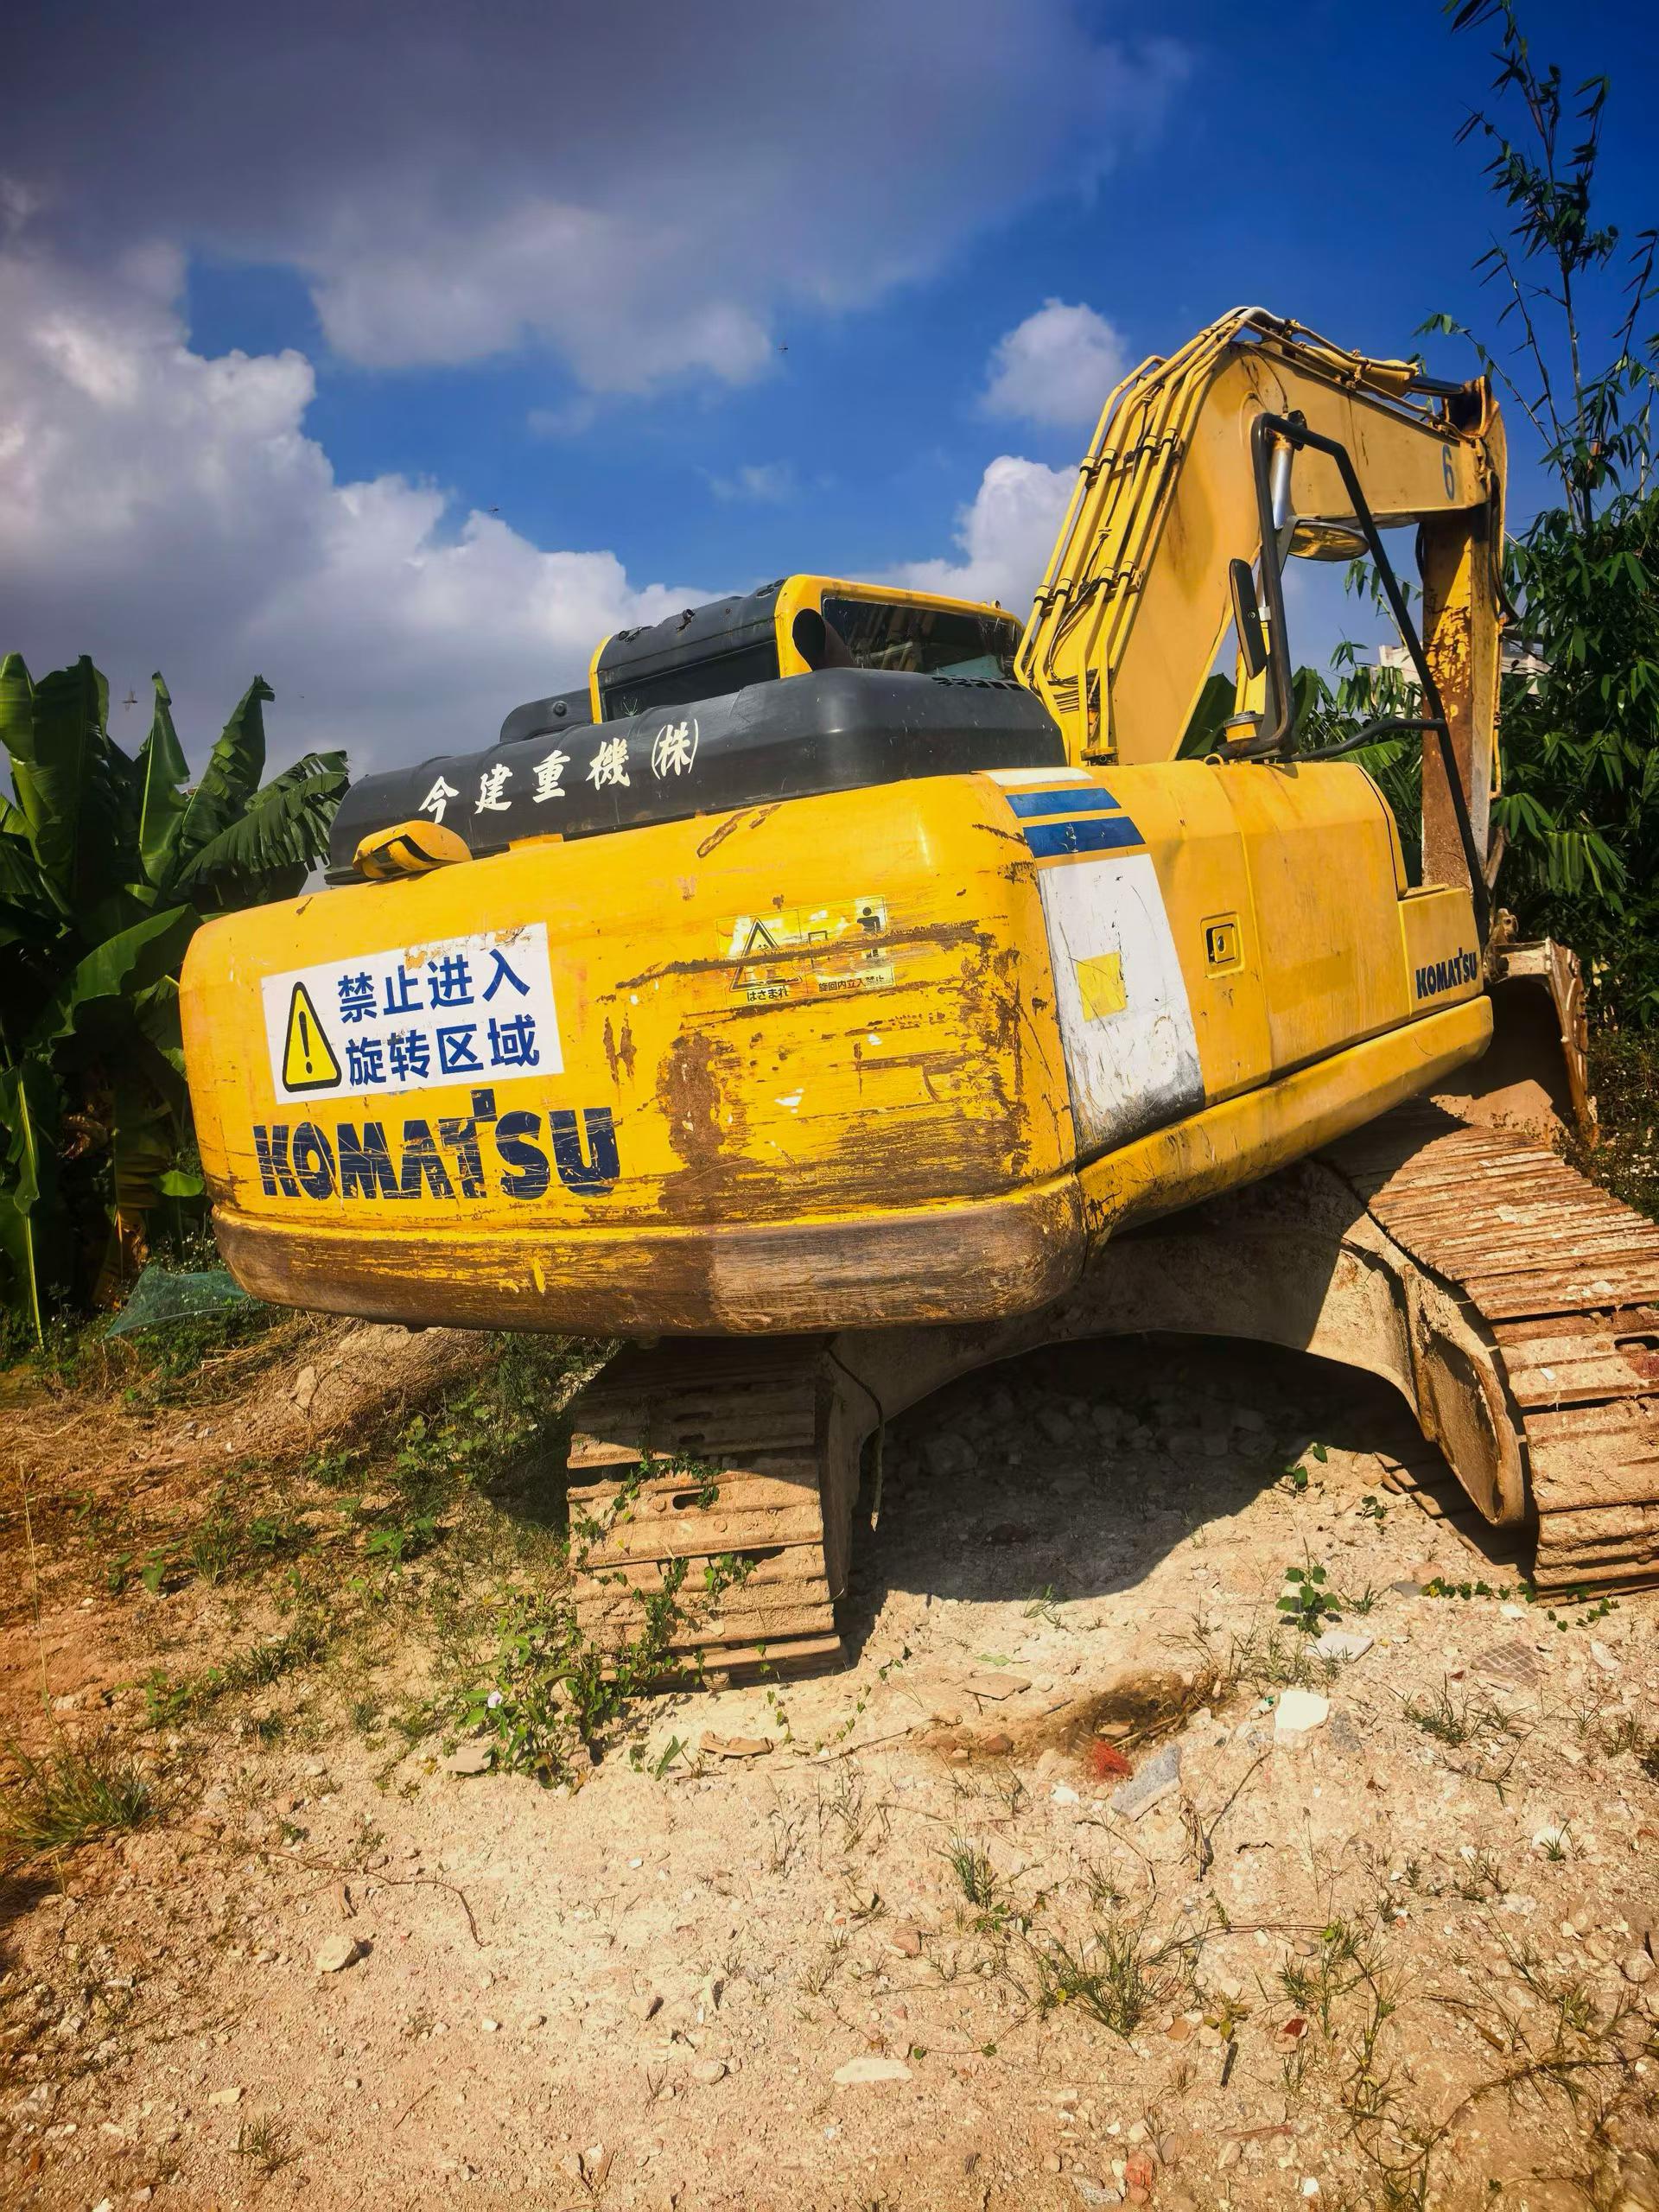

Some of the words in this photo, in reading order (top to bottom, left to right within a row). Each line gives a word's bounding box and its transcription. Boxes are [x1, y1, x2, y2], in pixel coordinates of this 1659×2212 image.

[1442, 442, 1455, 501] 6
[337, 948, 531, 1025] 禁止进入
[747, 985, 789, 1002] はさまれ
[1415, 947, 1478, 1000] KOMATSU
[345, 1014, 540, 1087] 旋转区域
[252, 1088, 621, 1201] KOMATSU
